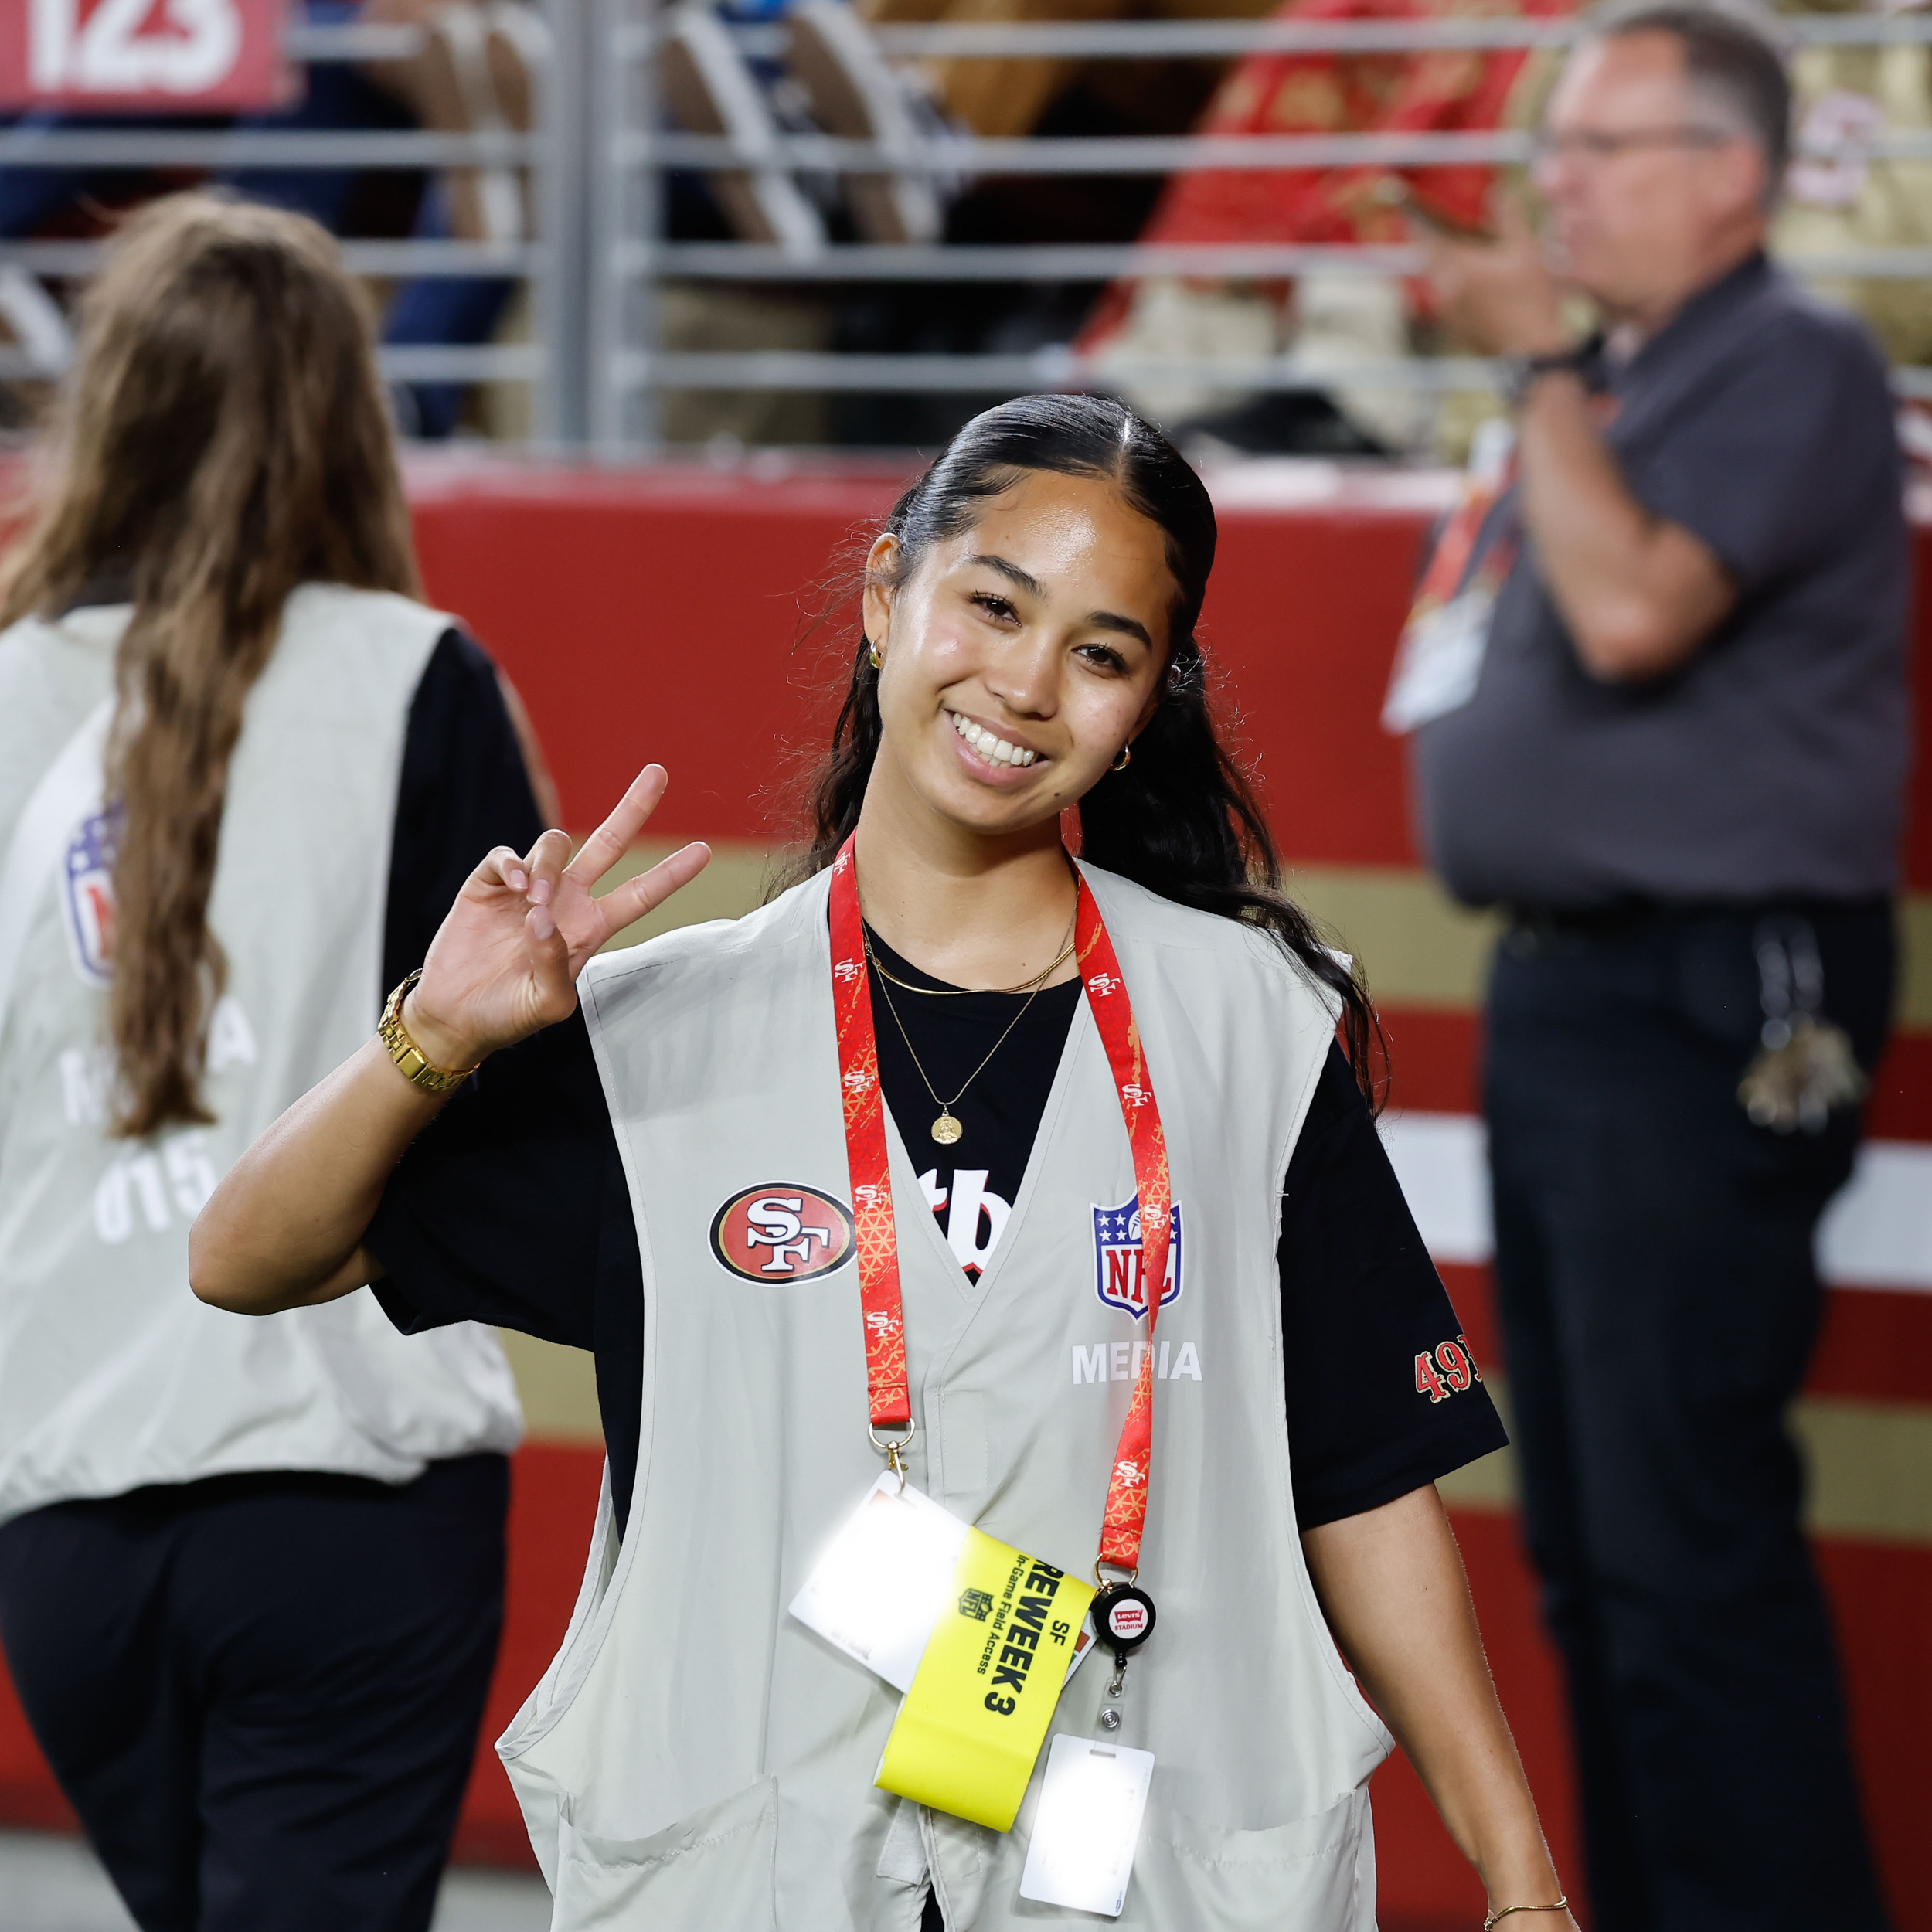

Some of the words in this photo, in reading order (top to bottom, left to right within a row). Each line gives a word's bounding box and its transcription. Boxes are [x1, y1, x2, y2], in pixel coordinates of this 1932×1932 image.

[834, 850, 851, 876] SF
[835, 957, 863, 984] SF
[1088, 972, 1121, 998] SF
[845, 1070, 876, 1094] SF
[1121, 1083, 1152, 1107] SF
[855, 1185, 888, 1209] SF
[1144, 1204, 1168, 1229] SF
[747, 1196, 831, 1273] SF
[866, 1311, 900, 1337] SF
[1072, 1341, 1203, 1385] MEDIA
[1116, 1461, 1145, 1488] SF
[1003, 1554, 1029, 1599] In-Game
[992, 1601, 1012, 1631] Field
[1049, 1620, 1070, 1646] SF
[977, 1631, 1001, 1675] Access
[984, 1692, 1015, 1716] 3
